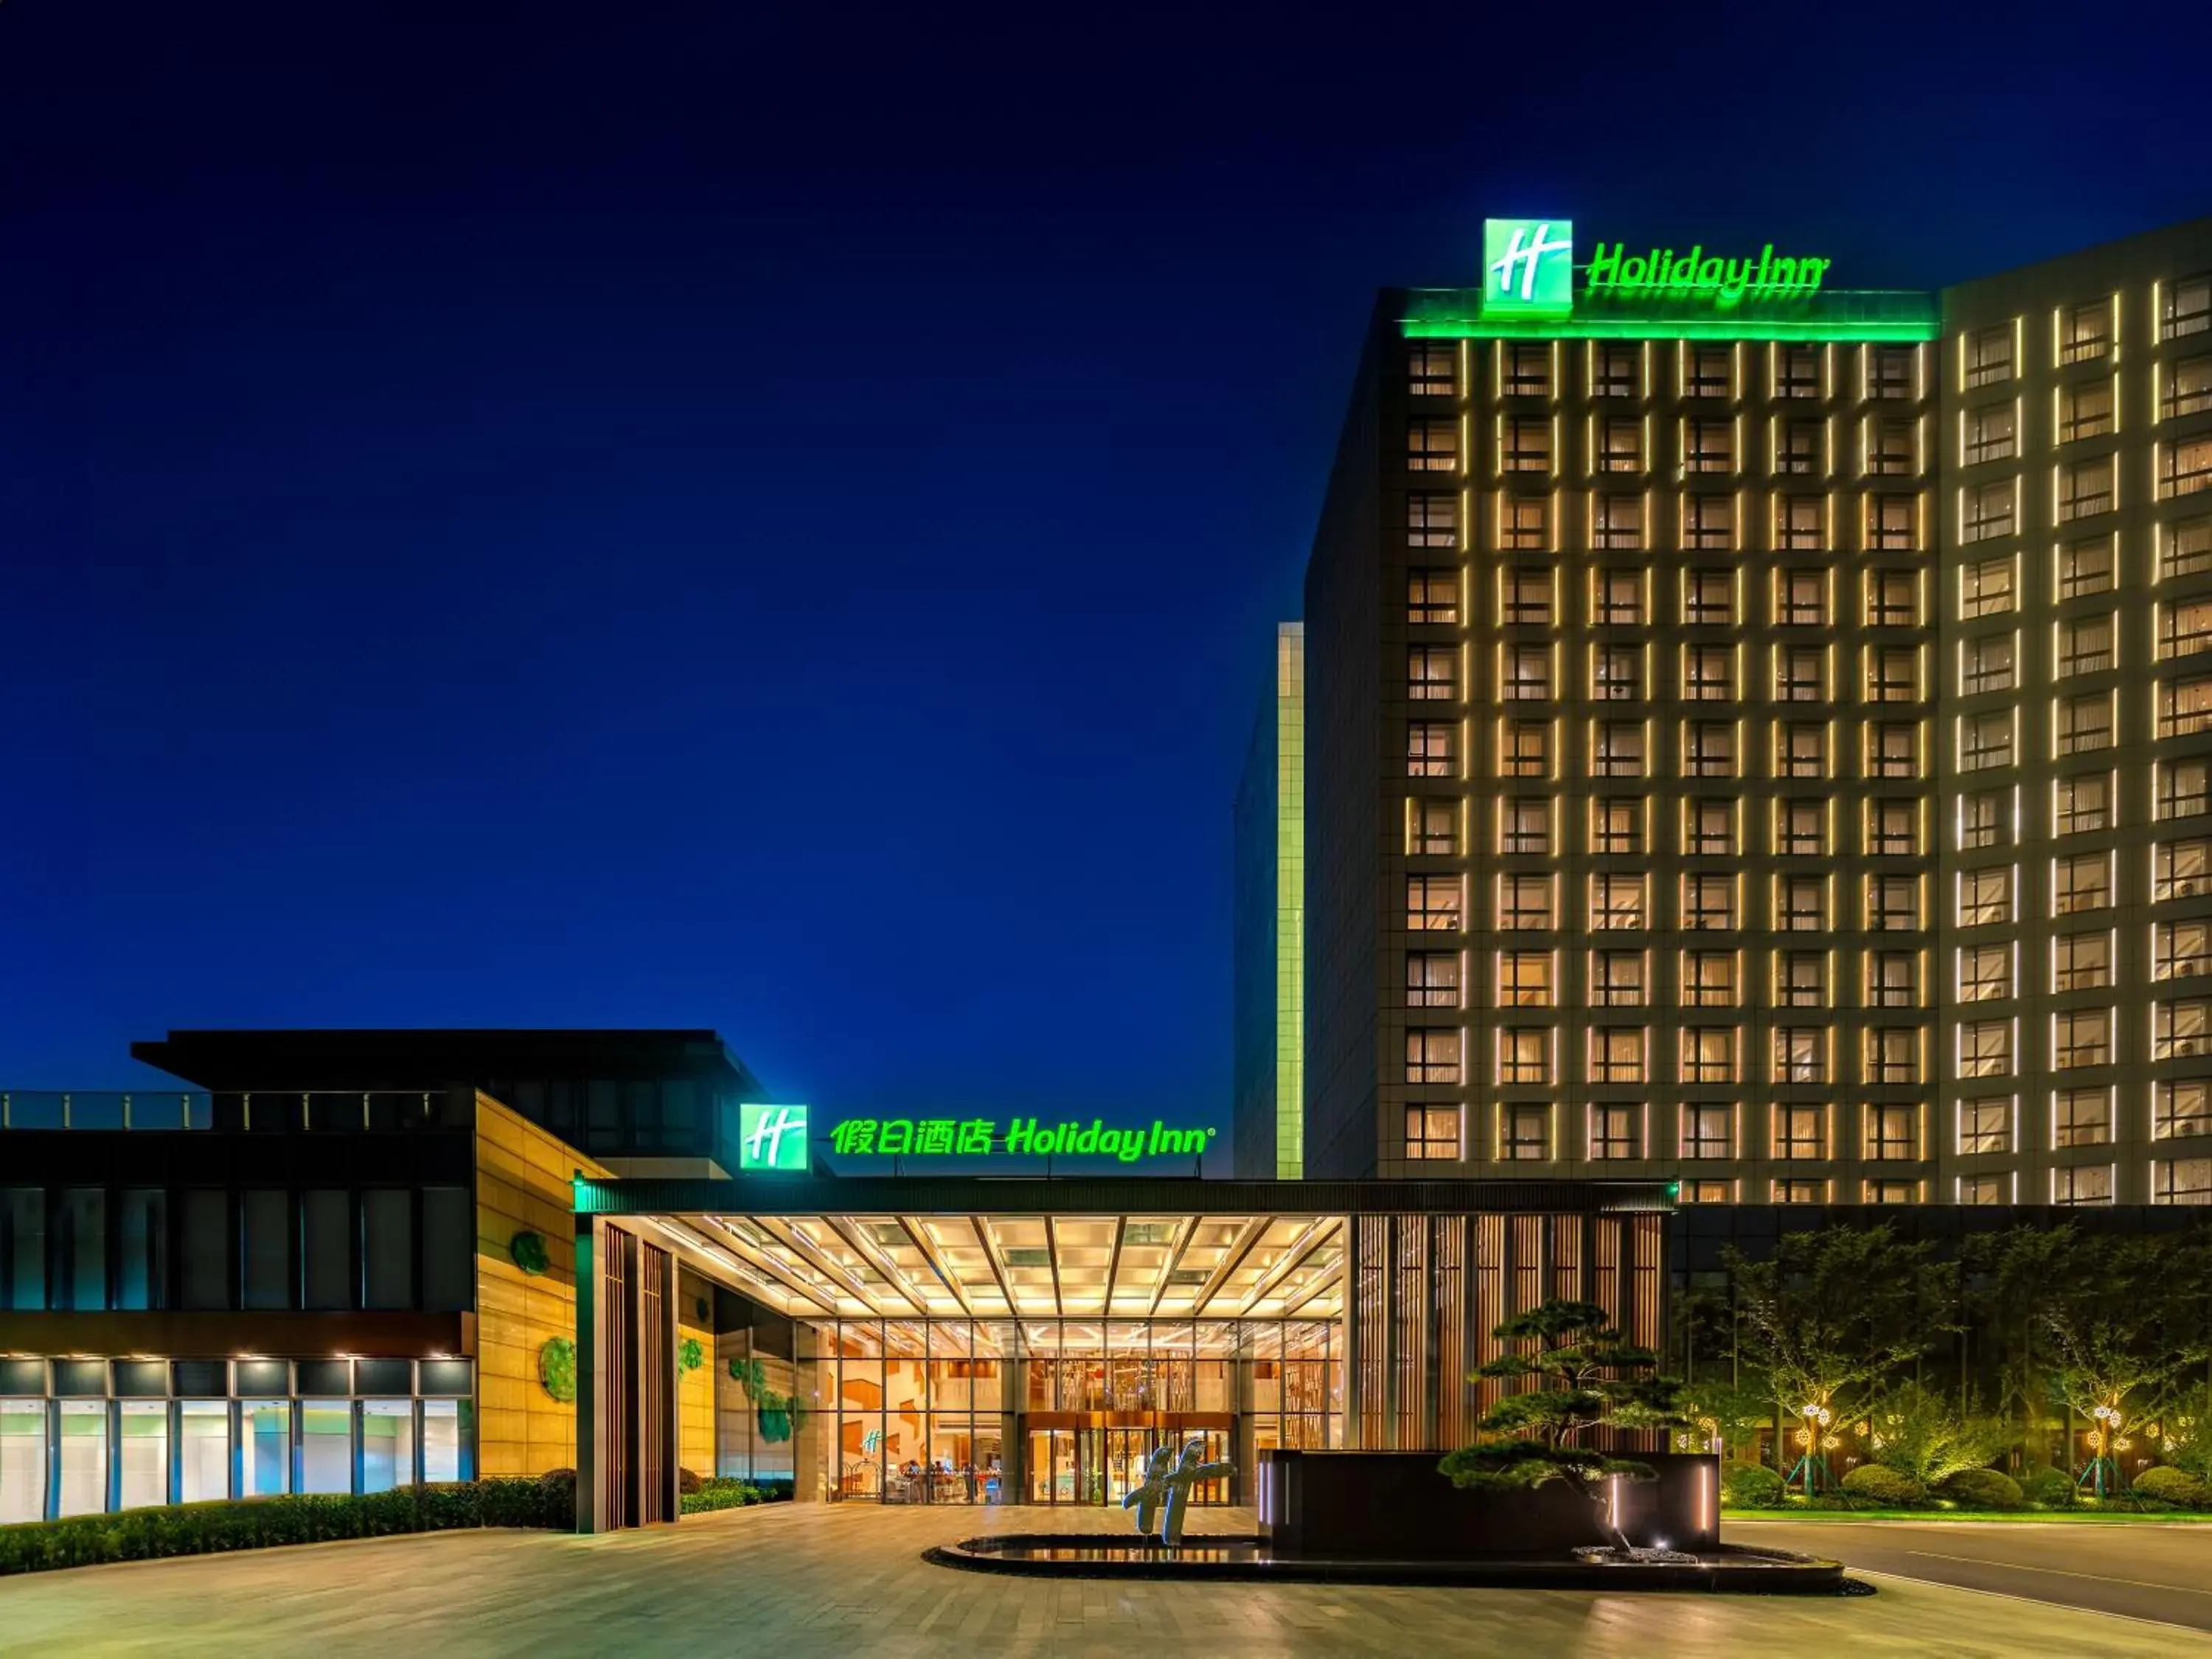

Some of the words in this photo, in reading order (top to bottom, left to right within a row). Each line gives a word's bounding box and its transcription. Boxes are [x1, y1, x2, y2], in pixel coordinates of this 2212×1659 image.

[1587, 243, 1752, 298] Holiday
[830, 1119, 995, 1155] 假日酒店
[1006, 1119, 1146, 1161] Holiday
